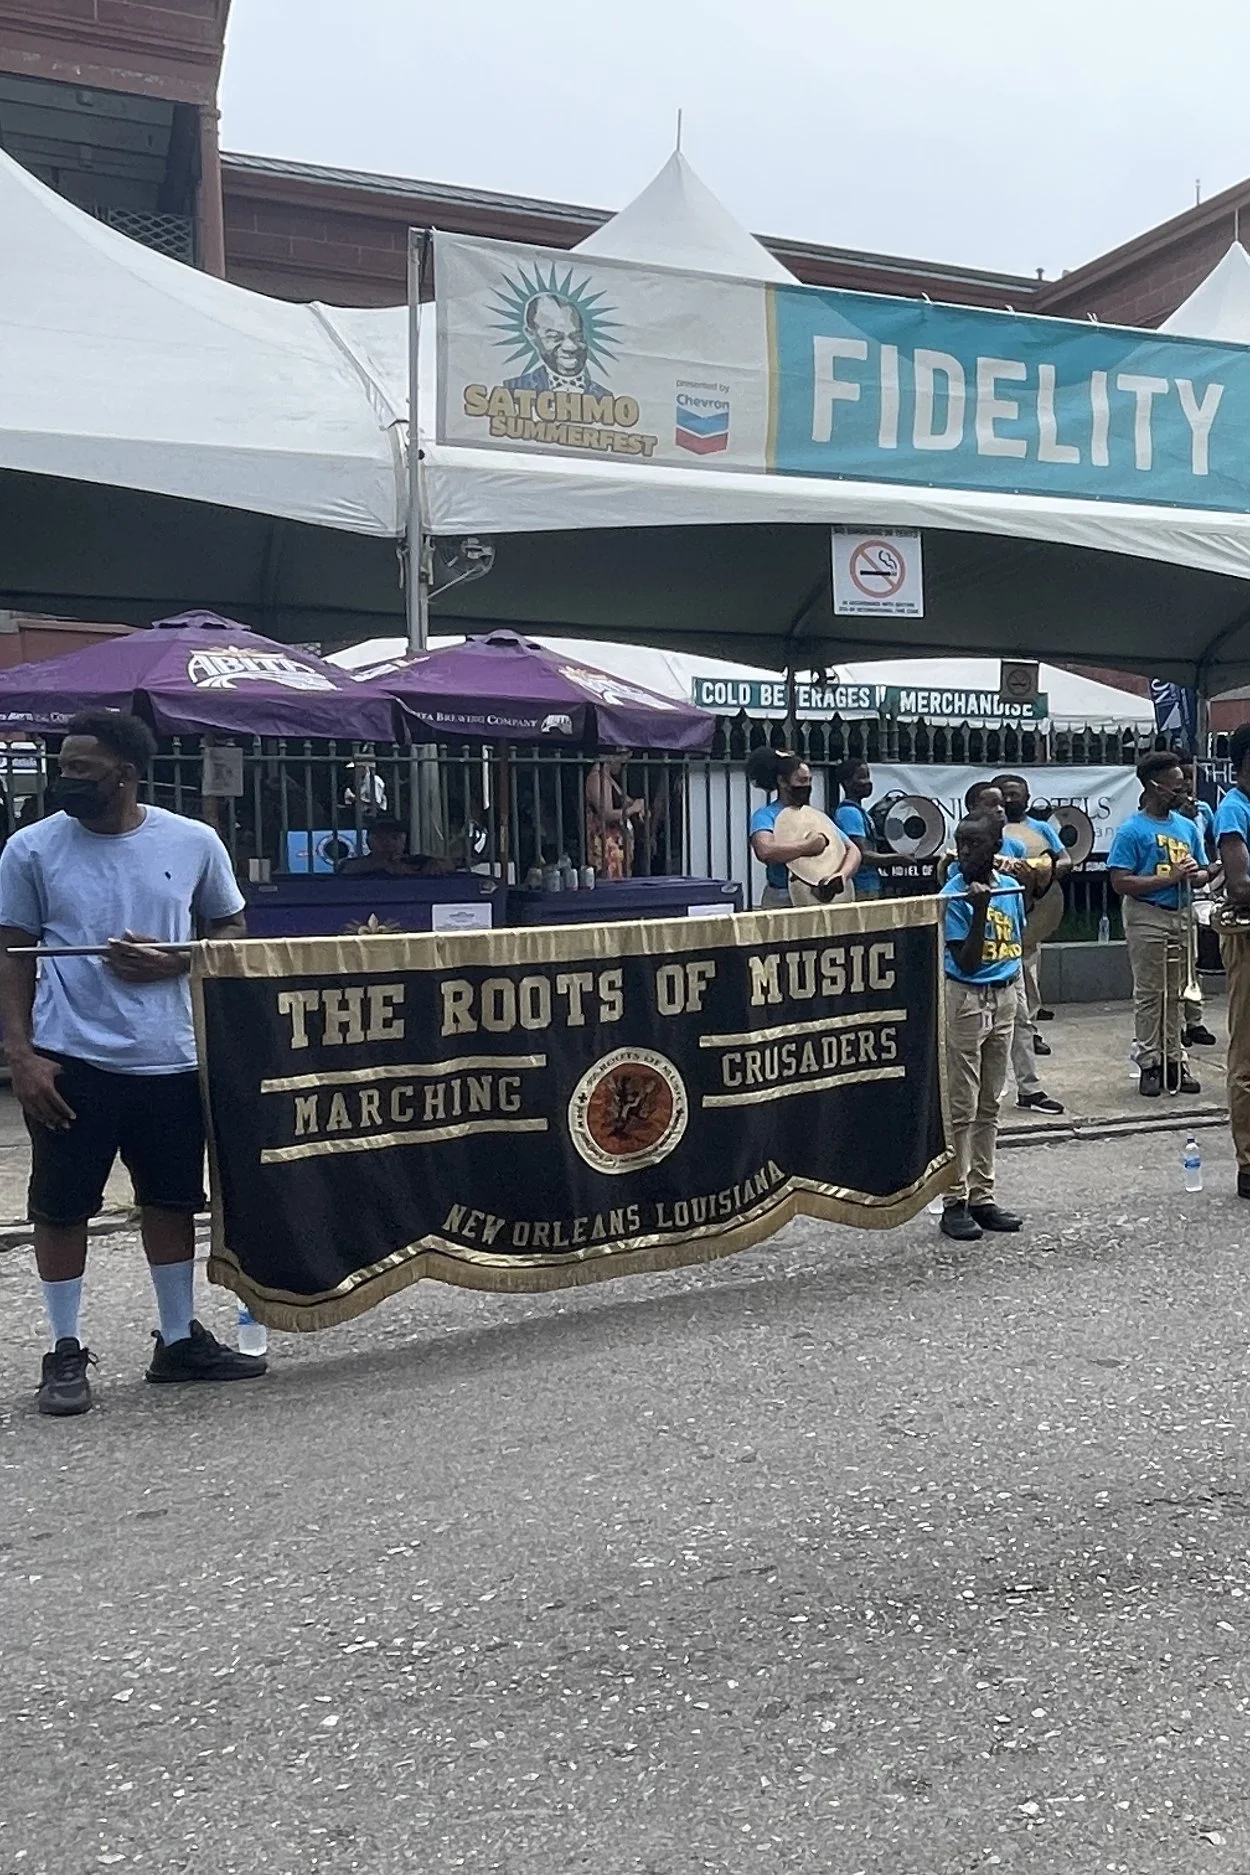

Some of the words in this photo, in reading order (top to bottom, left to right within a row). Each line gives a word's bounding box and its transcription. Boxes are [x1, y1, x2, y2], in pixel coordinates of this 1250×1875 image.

[464, 384, 640, 427] SATCHMO
[676, 379, 719, 391] presented
[676, 393, 730, 408] Chevron
[811, 335, 1224, 476] FIDELITY
[489, 415, 658, 457] SUMMERFEST
[187, 655, 316, 683] ABITA
[702, 682, 751, 706] COLD
[760, 685, 871, 708] BEERAGES
[487, 715, 538, 727] COMPANY
[1199, 762, 1238, 784] THE
[279, 983, 405, 1049] THE
[440, 968, 624, 1037] ROOTS
[656, 960, 717, 1018] OF
[749, 942, 897, 1007] MUSIC
[721, 1027, 898, 1088] CRUSADERS
[294, 1075, 522, 1137] MARCHING
[442, 1203, 507, 1246] NEW
[512, 1203, 641, 1249] ORLEANS
[654, 1160, 786, 1230] LOUISIANA
